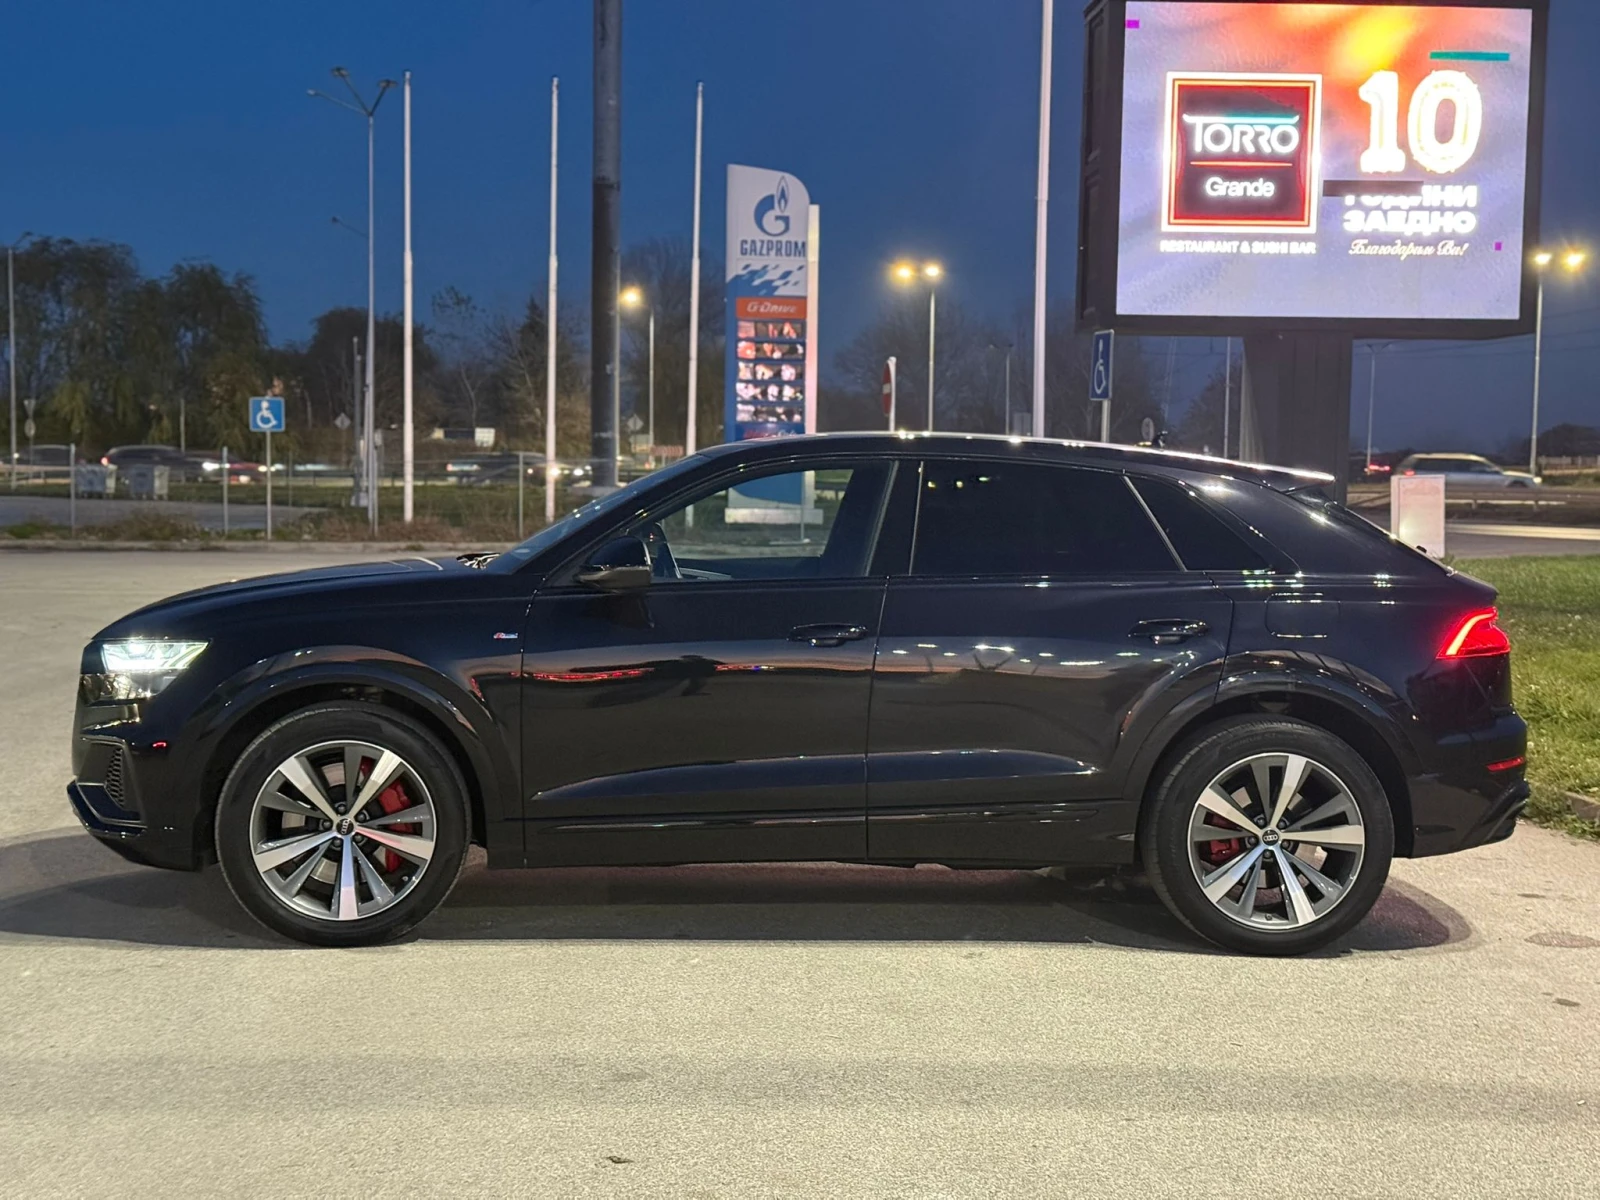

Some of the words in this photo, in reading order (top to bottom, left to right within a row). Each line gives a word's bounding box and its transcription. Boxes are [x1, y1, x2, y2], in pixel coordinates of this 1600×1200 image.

[1358, 69, 1483, 174] 10
[1182, 113, 1300, 153] TORRO
[1205, 176, 1275, 197] Grande
[740, 239, 807, 258] GAZPROM
[1160, 240, 1239, 253] RESTAURANT
[1239, 240, 1250, 253] &
[1252, 241, 1288, 254] SUSHI
[1289, 242, 1317, 254] BAR
